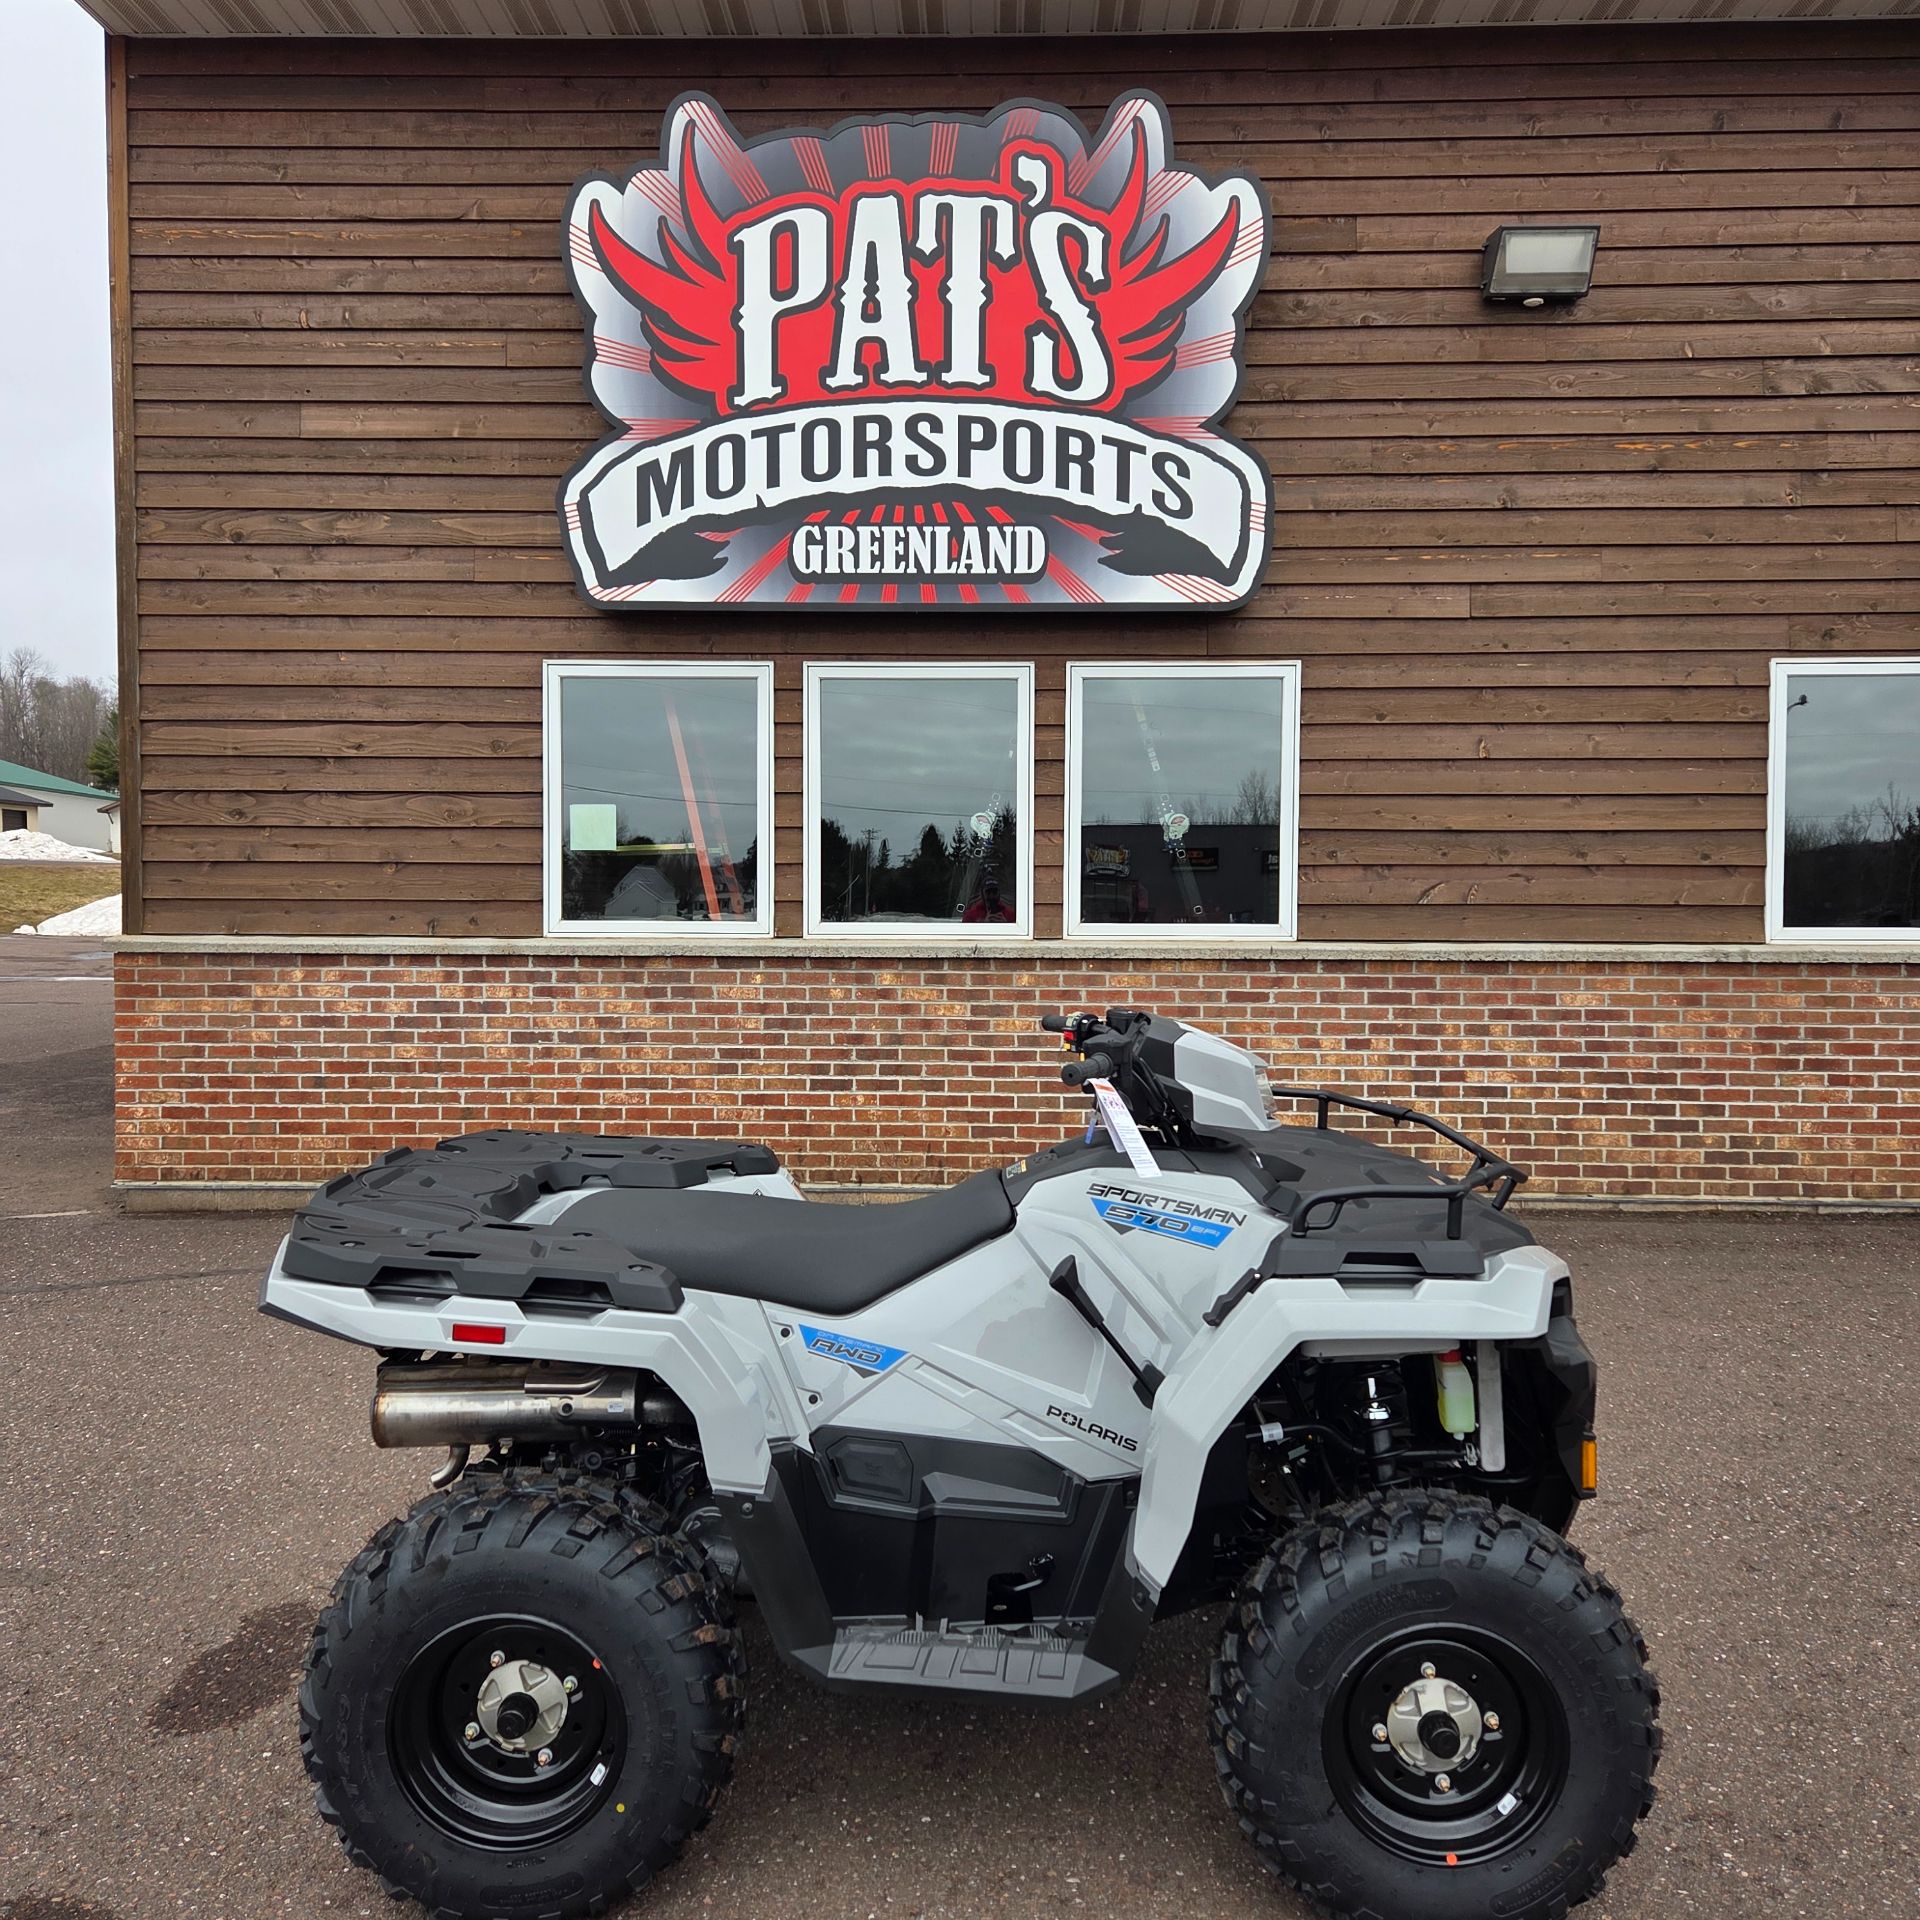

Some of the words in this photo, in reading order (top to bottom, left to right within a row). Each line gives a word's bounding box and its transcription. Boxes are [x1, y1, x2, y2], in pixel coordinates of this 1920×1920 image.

[733, 154, 1109, 407] PAT'S
[636, 412, 1194, 528] MOTORSPORTS
[792, 524, 1046, 575] GREENLAND
[1086, 1183, 1248, 1227] SPORTSMAN
[1104, 1205, 1191, 1233] 570
[811, 1337, 882, 1364] AWD
[1046, 1404, 1138, 1452] POLARIS
